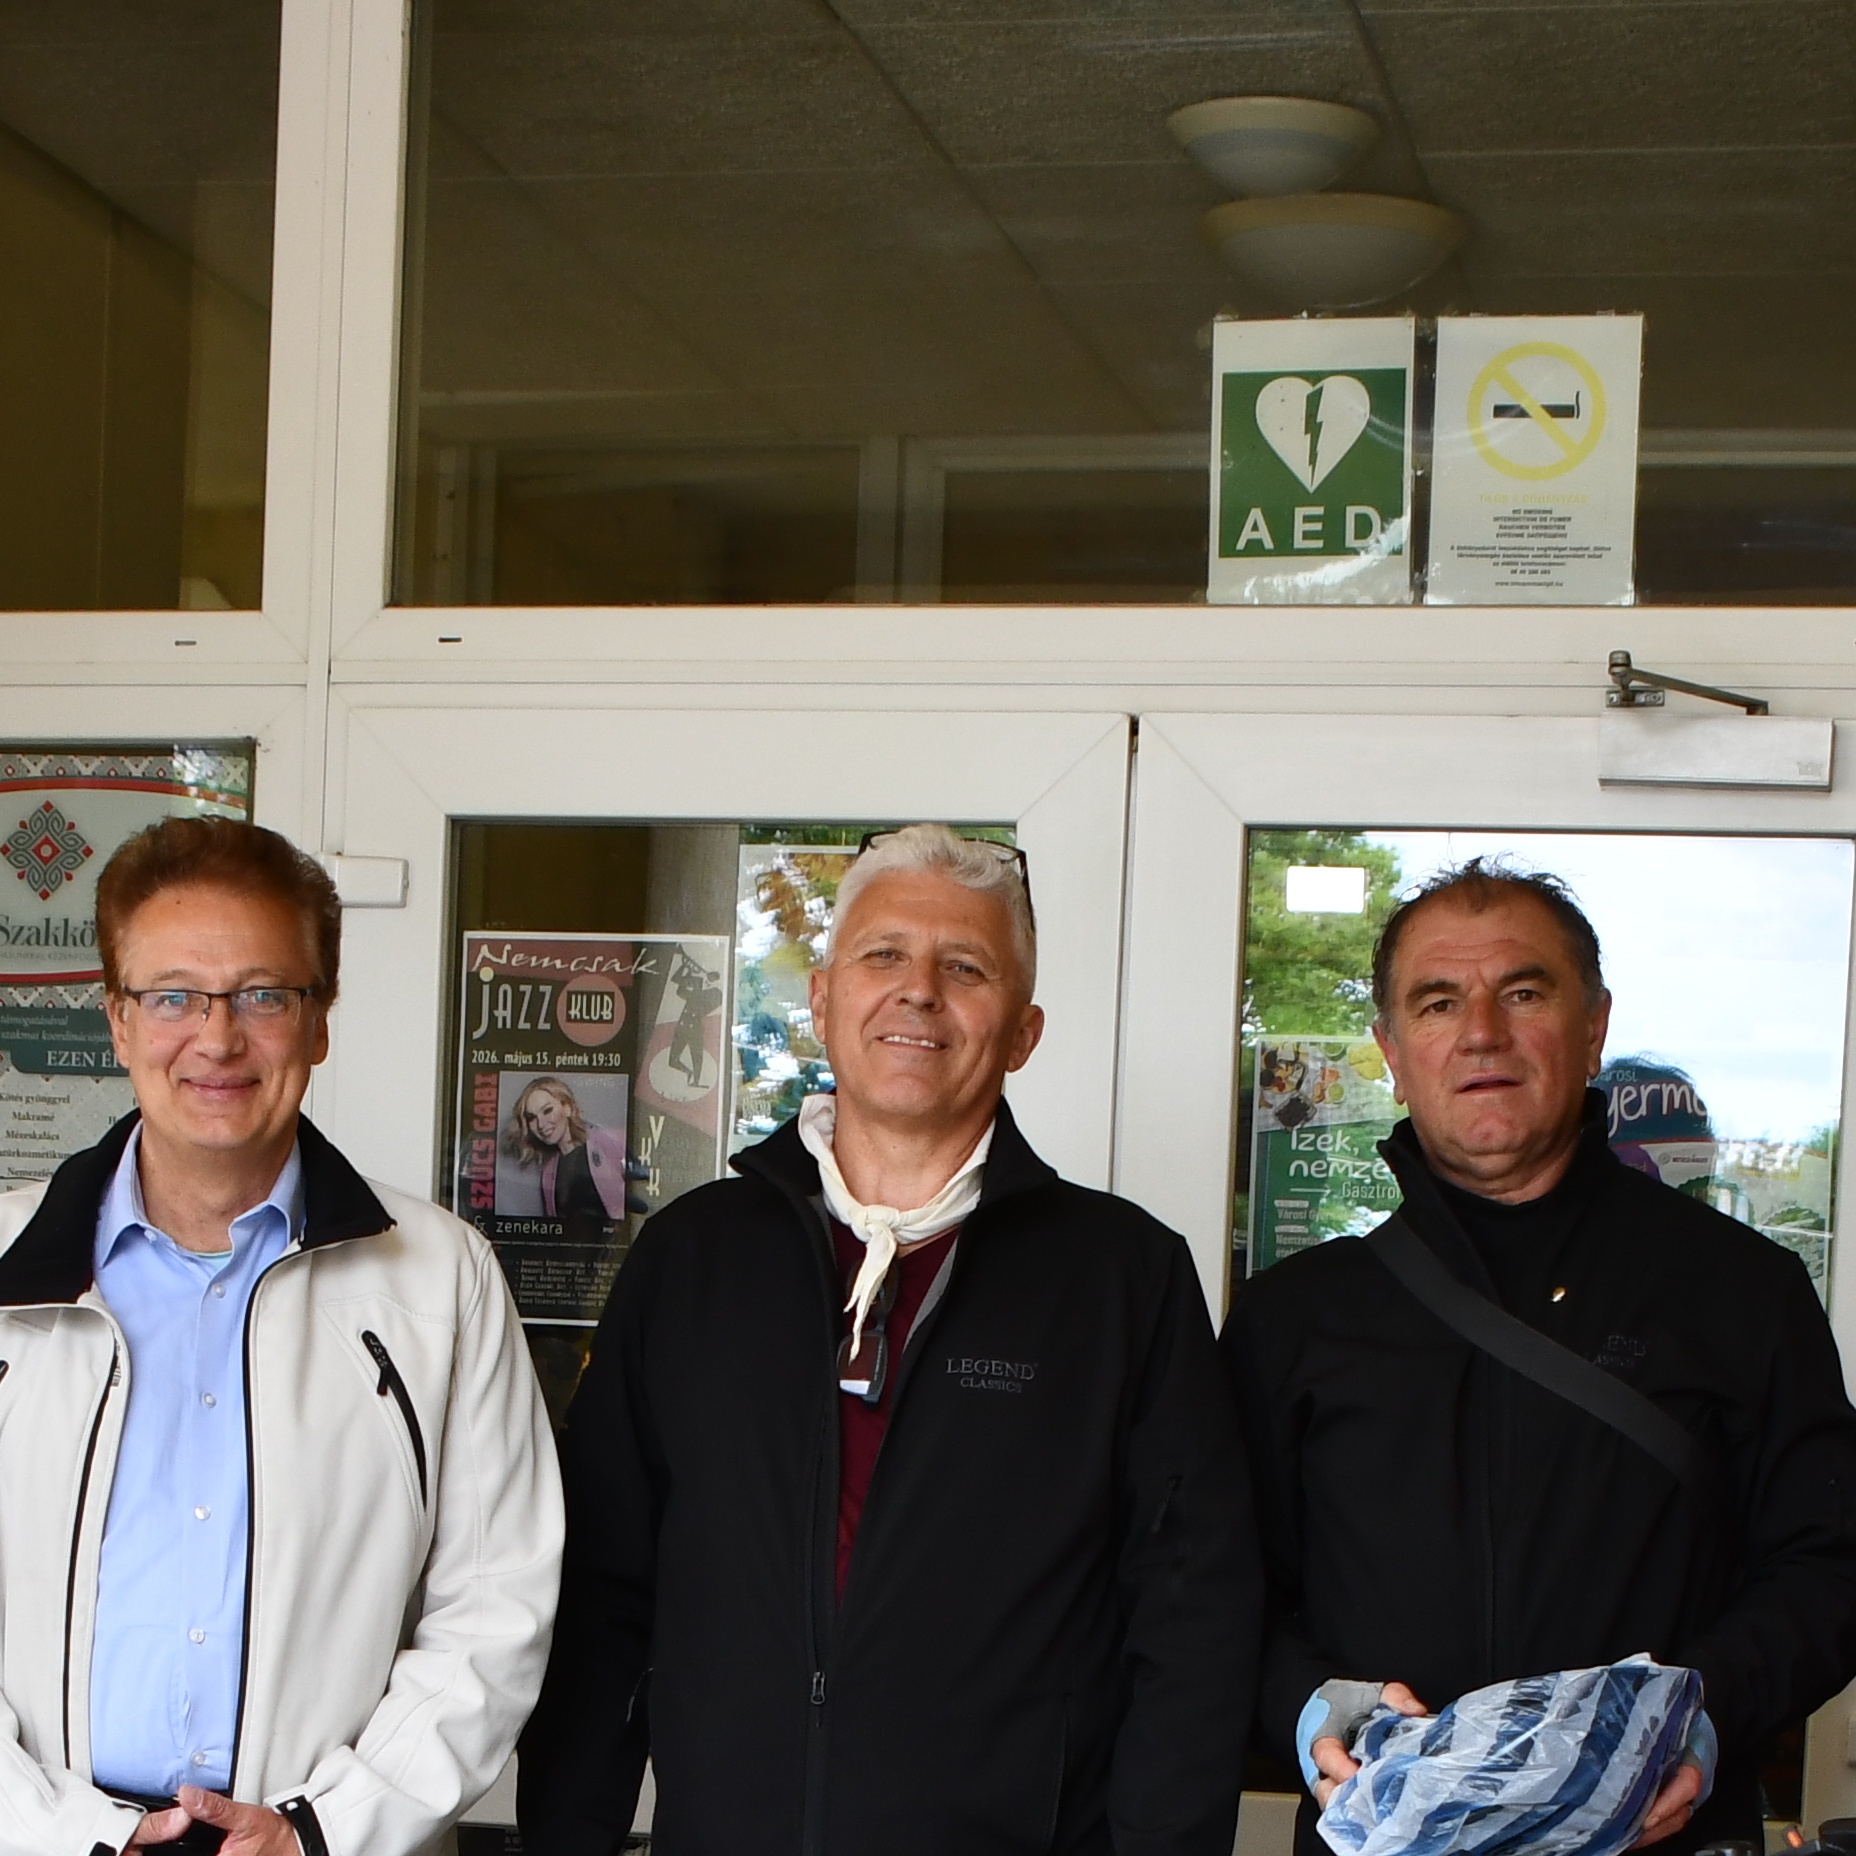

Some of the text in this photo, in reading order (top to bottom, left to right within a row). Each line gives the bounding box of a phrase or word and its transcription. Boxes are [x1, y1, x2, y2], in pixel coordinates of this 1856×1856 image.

[1235, 504, 1383, 552] AED
[471, 942, 661, 977] Nemcsak
[567, 992, 614, 1022] KLUB
[47, 1050, 96, 1067] EZEN
[471, 1049, 622, 1069] 2026. május 15. péntek 19:30
[1597, 1069, 1638, 1082] árosi
[473, 1072, 498, 1132] GABI
[12, 1111, 56, 1123] Makramé
[1288, 1158, 1394, 1181] nemze
[495, 1220, 564, 1236] zenekara
[946, 1357, 1035, 1380] LEGEND
[960, 1377, 1023, 1393] CLASSICS
